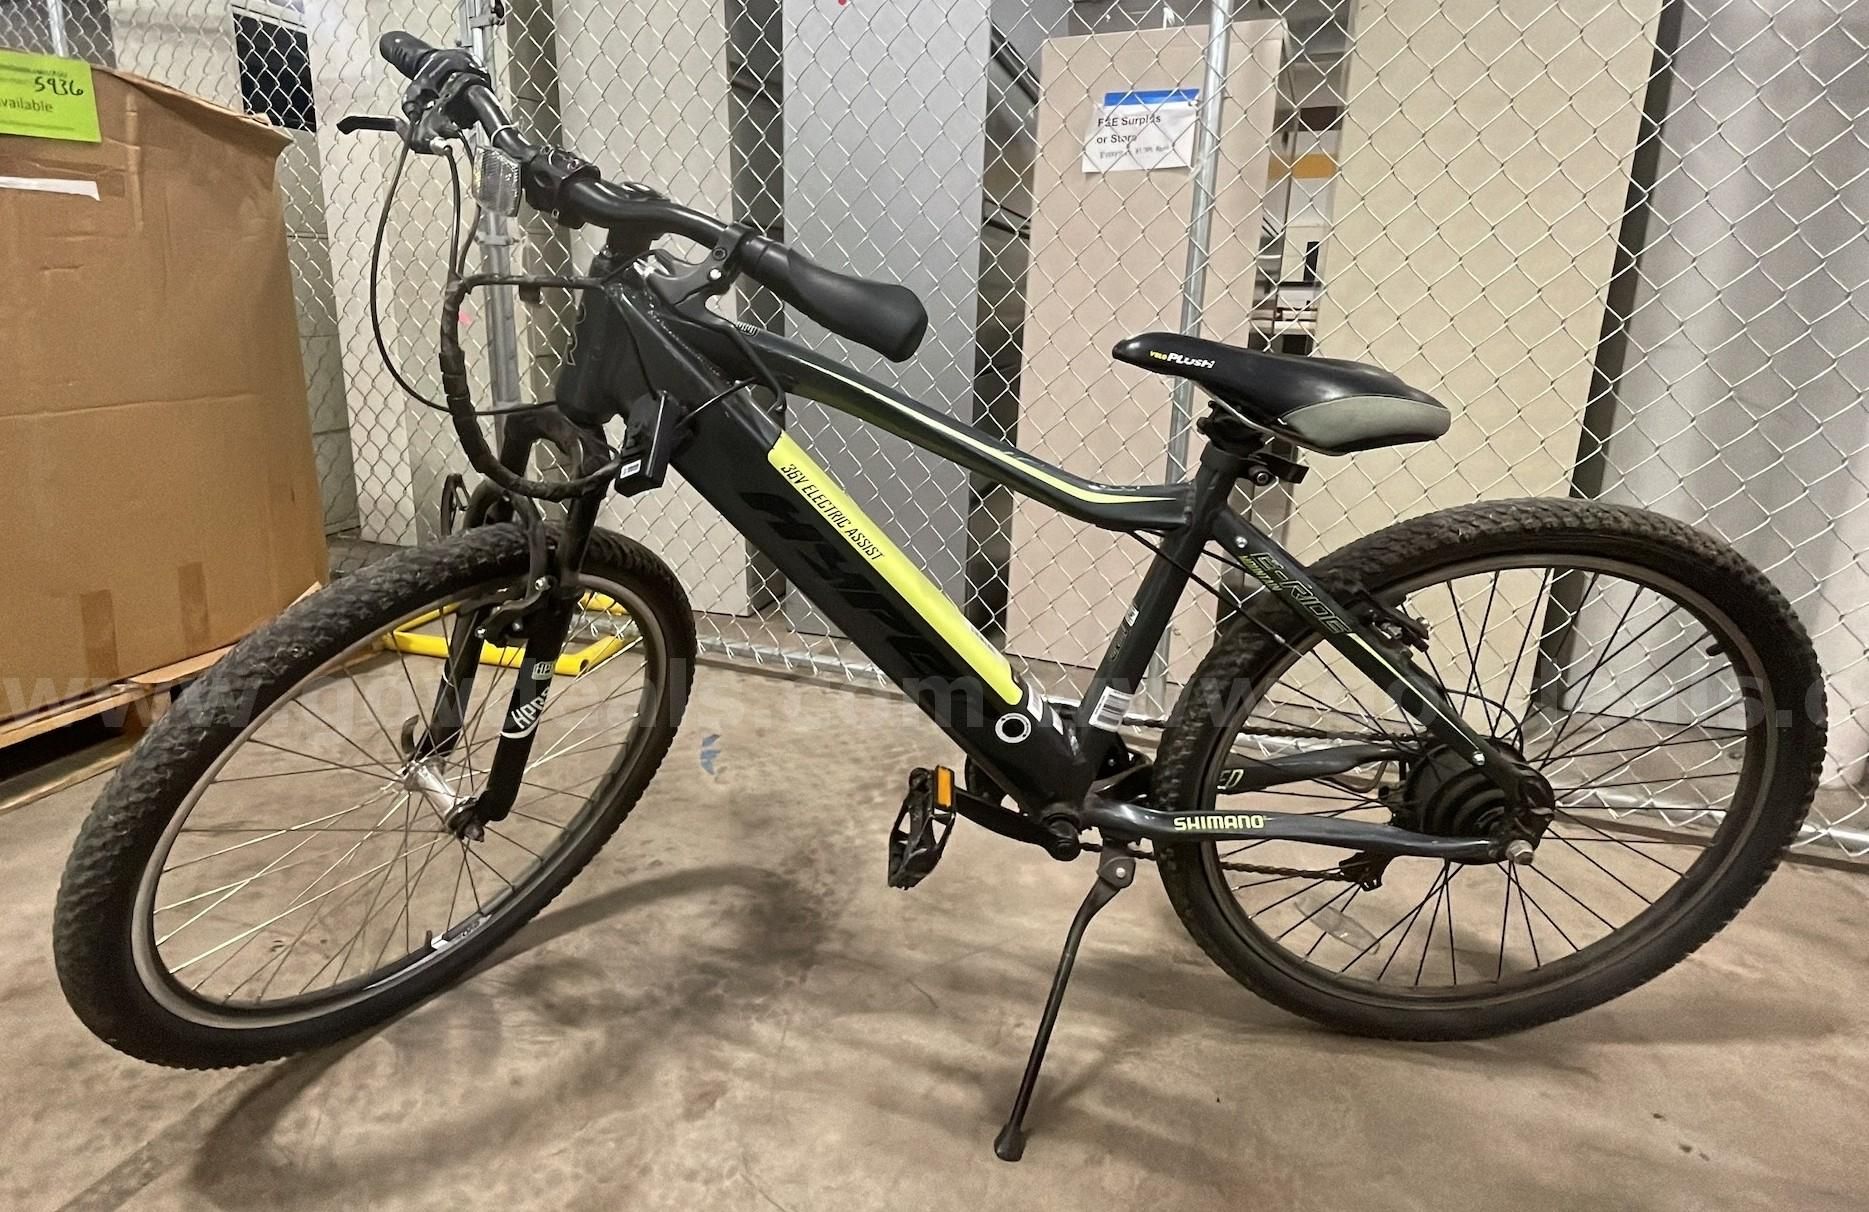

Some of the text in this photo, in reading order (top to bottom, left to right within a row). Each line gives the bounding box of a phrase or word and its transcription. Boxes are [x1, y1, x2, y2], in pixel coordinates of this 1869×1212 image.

[34, 76, 84, 96] 5936
[1096, 136, 1108, 144] or
[1166, 352, 1216, 369] PLUSH
[780, 463, 885, 560] 36V ELECTRIC ASSIST
[1249, 551, 1353, 634] E-RIDE
[1173, 814, 1265, 831] SHIMANO
